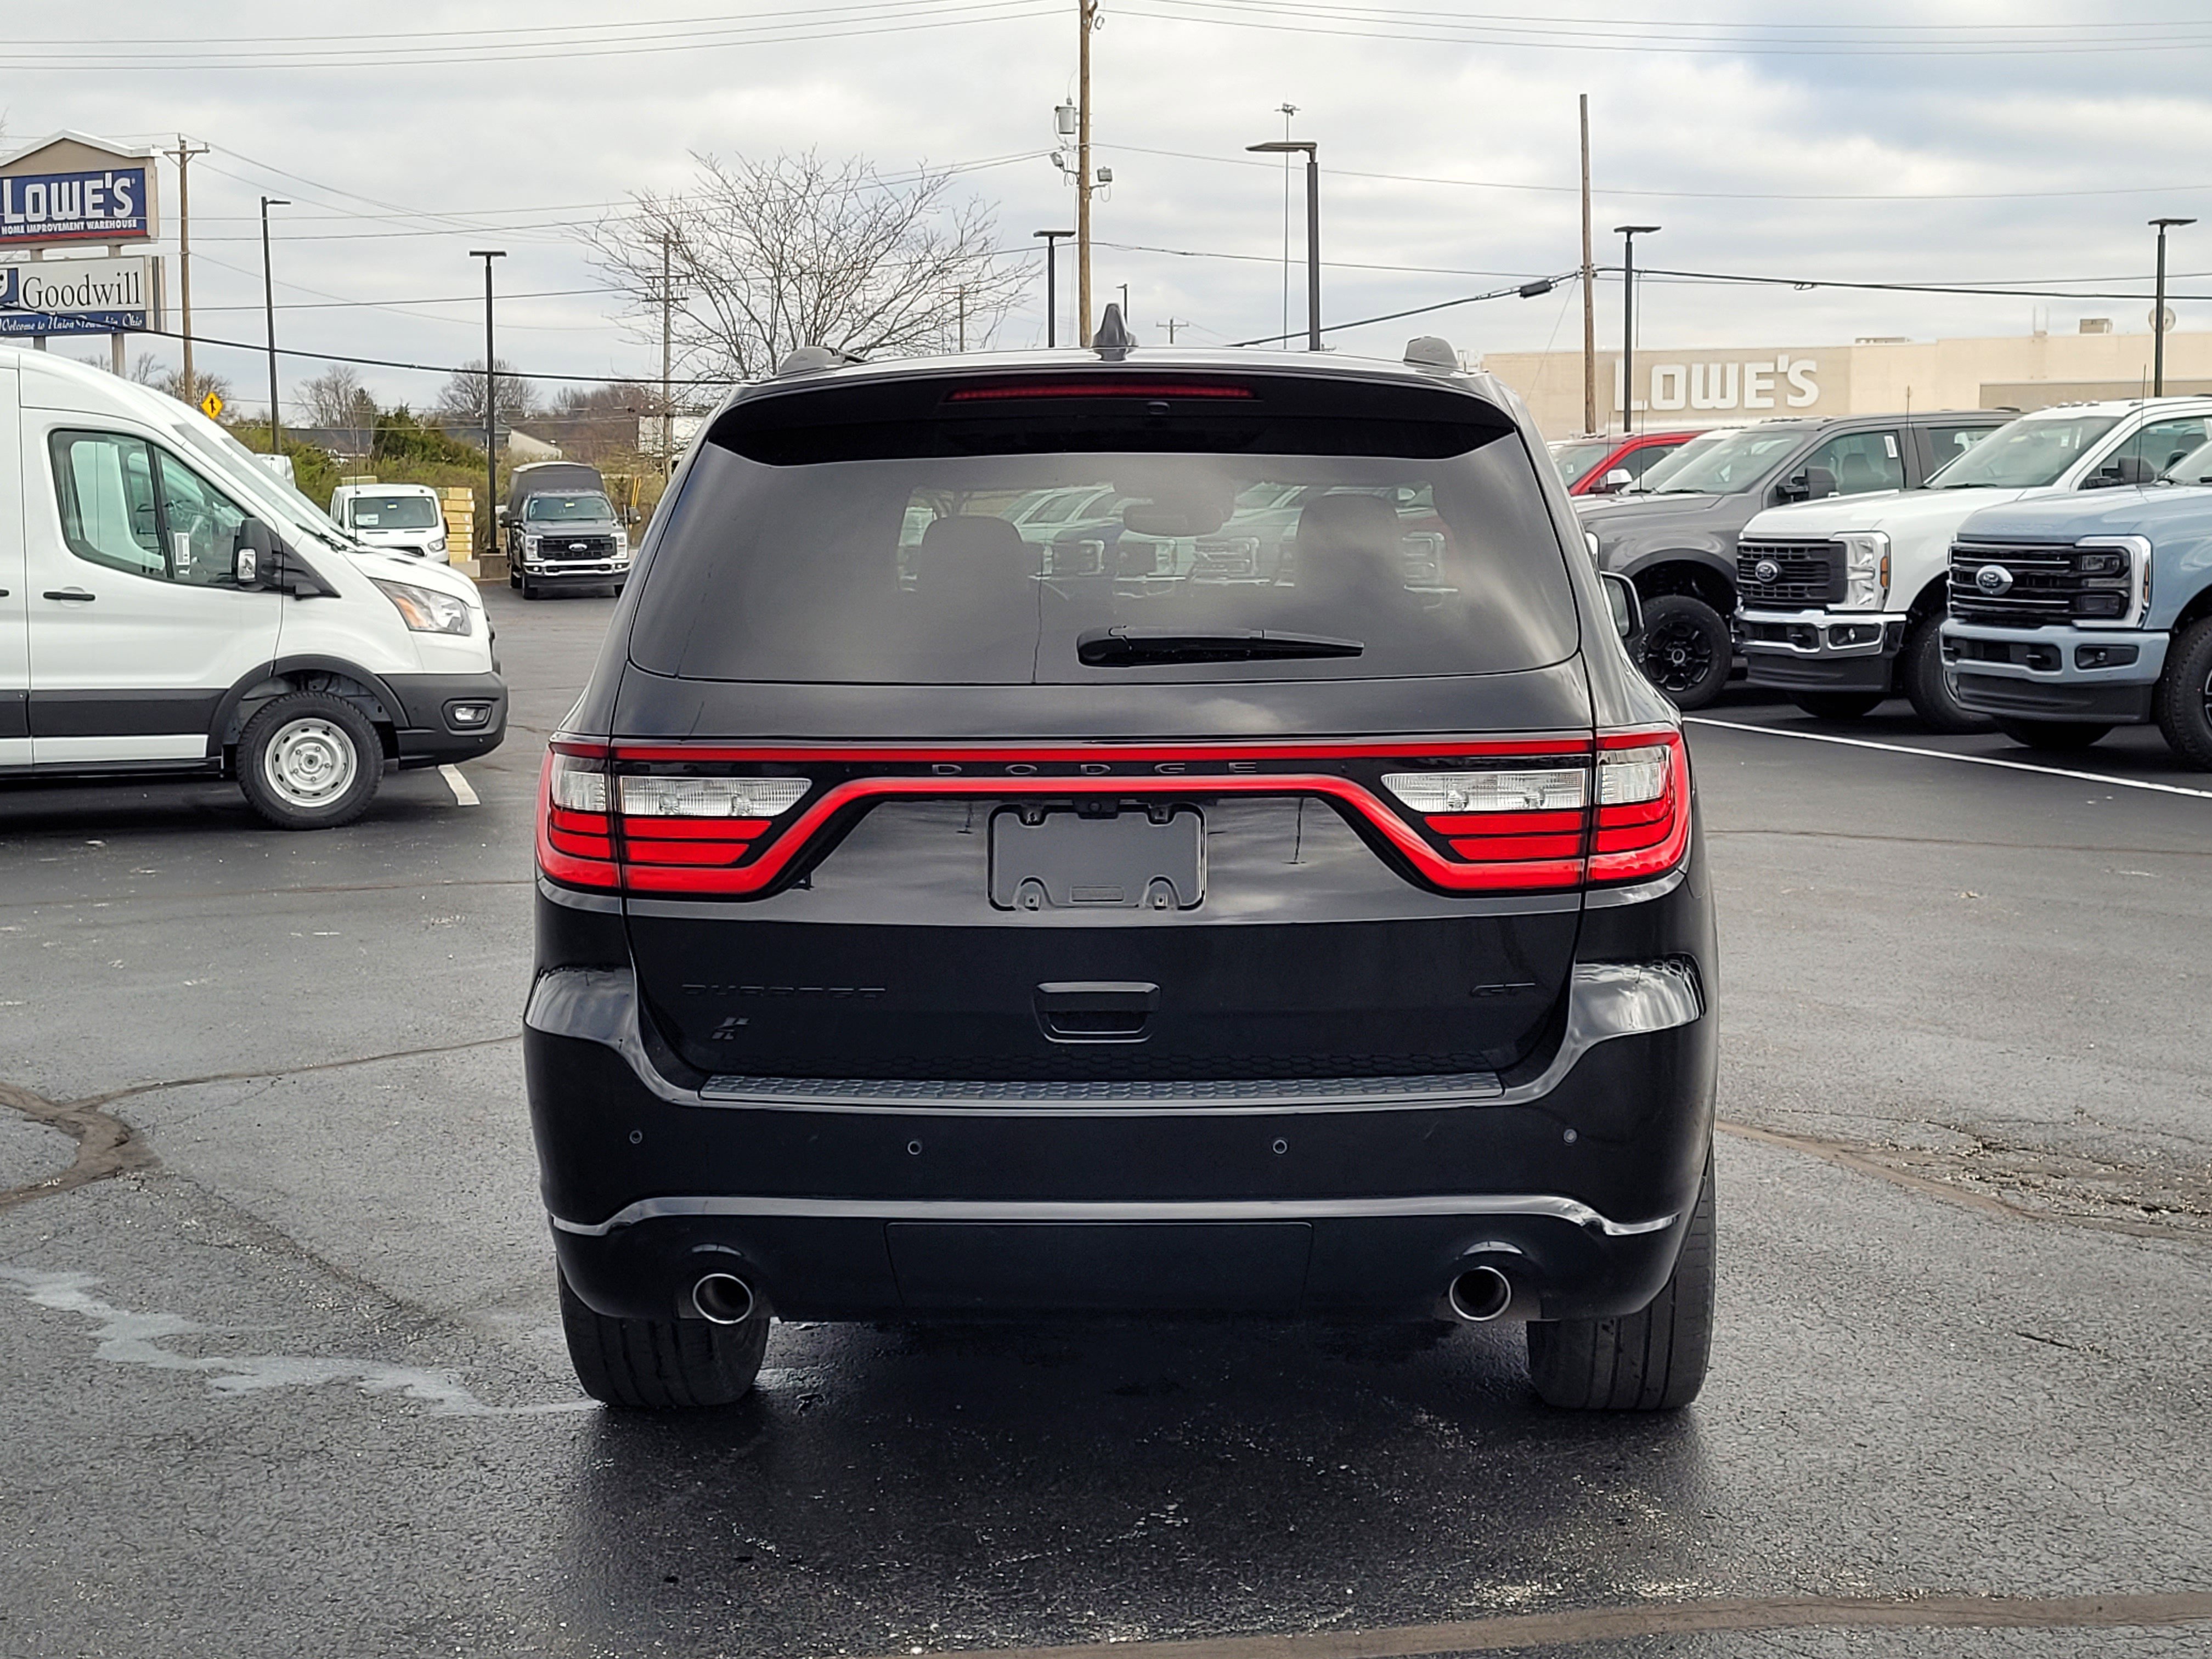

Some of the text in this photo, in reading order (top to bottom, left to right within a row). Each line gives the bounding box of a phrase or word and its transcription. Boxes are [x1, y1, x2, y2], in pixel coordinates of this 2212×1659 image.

[3, 173, 133, 223] LOWE'S
[2, 219, 137, 235] HOME IMPROVEMENT WAREHOUSE
[22, 272, 140, 308] Goodwill
[38, 321, 45, 330] to
[1615, 355, 1819, 411] LOWE'S
[932, 762, 1257, 775] DODGE
